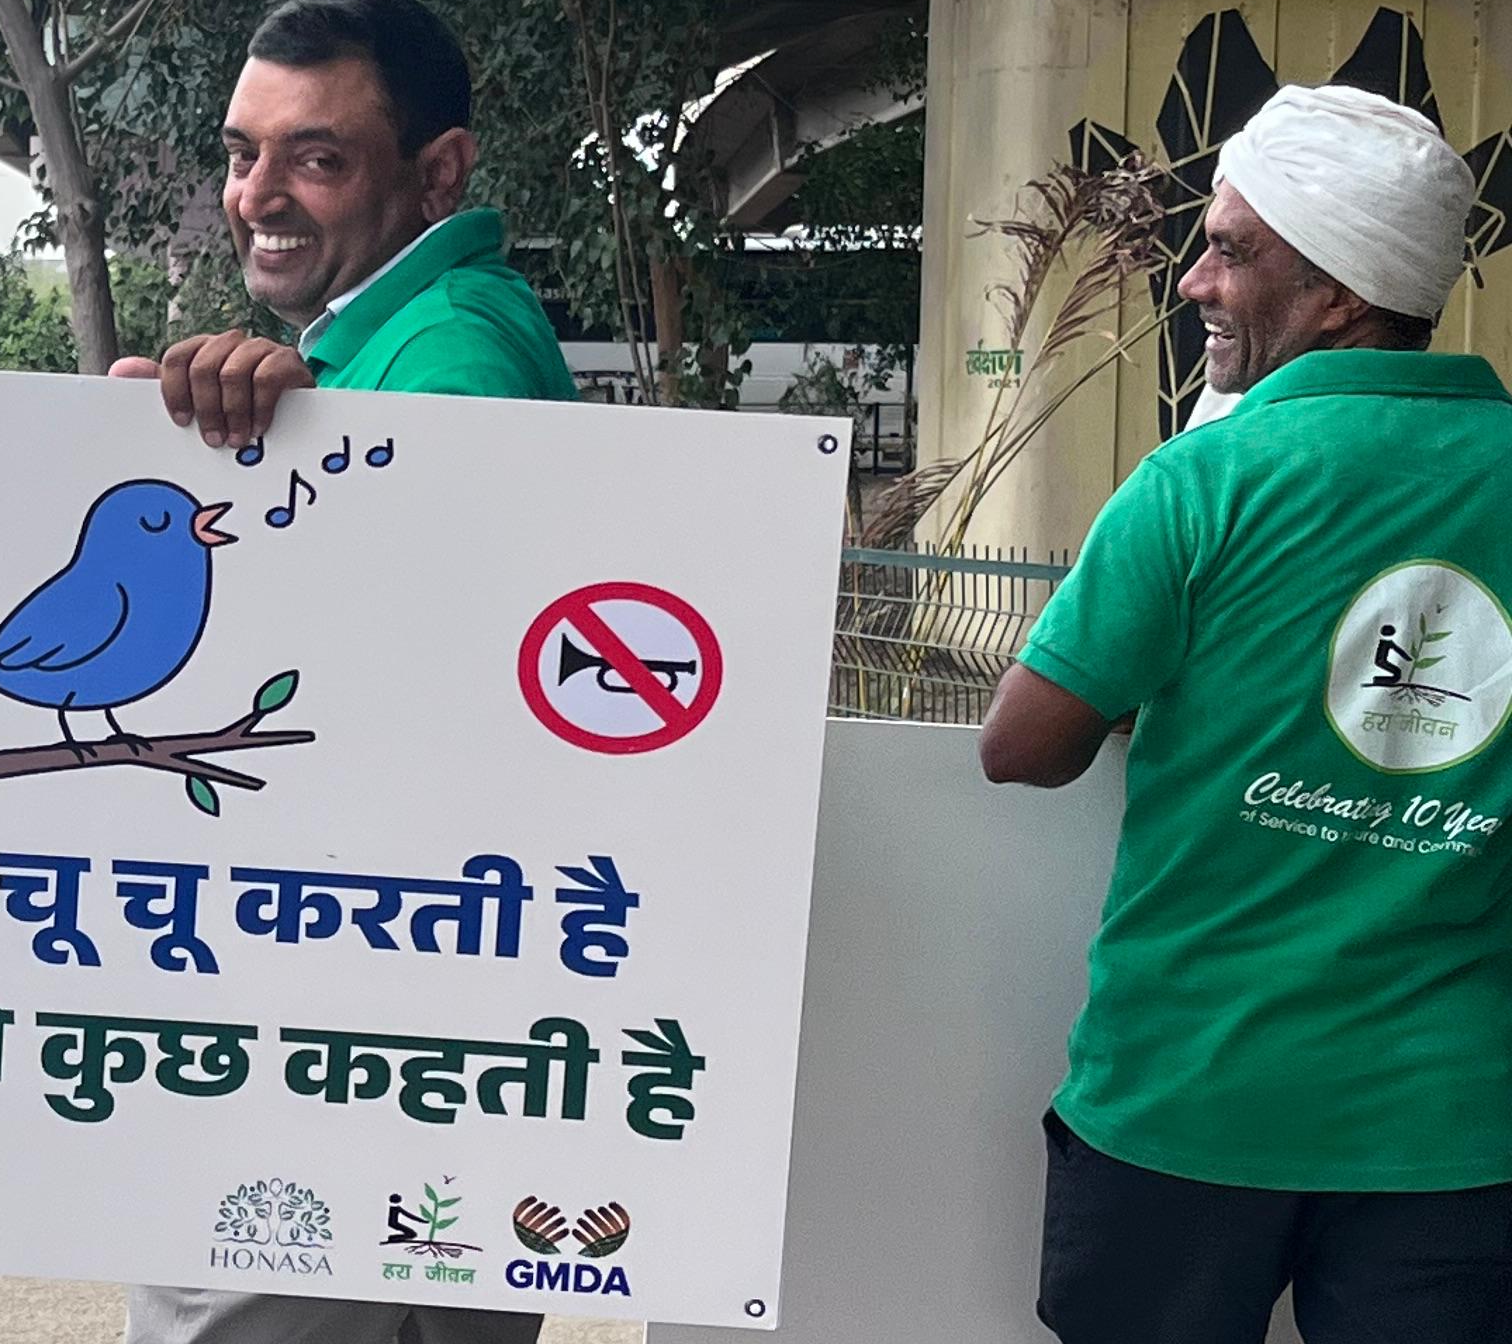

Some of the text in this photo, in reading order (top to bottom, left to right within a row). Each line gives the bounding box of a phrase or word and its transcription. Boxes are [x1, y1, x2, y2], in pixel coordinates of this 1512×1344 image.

[1401, 794, 1442, 828] 10
[1258, 811, 1318, 837] Service
[1320, 825, 1339, 843] to
[1382, 834, 1416, 852] and
[111, 859, 220, 975] चू
[230, 852, 534, 959] करती
[554, 855, 640, 978] है
[35, 1011, 259, 1123] कुछ
[279, 1016, 600, 1125] कहती
[621, 1017, 706, 1141] है
[210, 1247, 334, 1276] HONASA
[382, 1262, 413, 1280] हरा
[505, 1258, 632, 1297] GMDA
